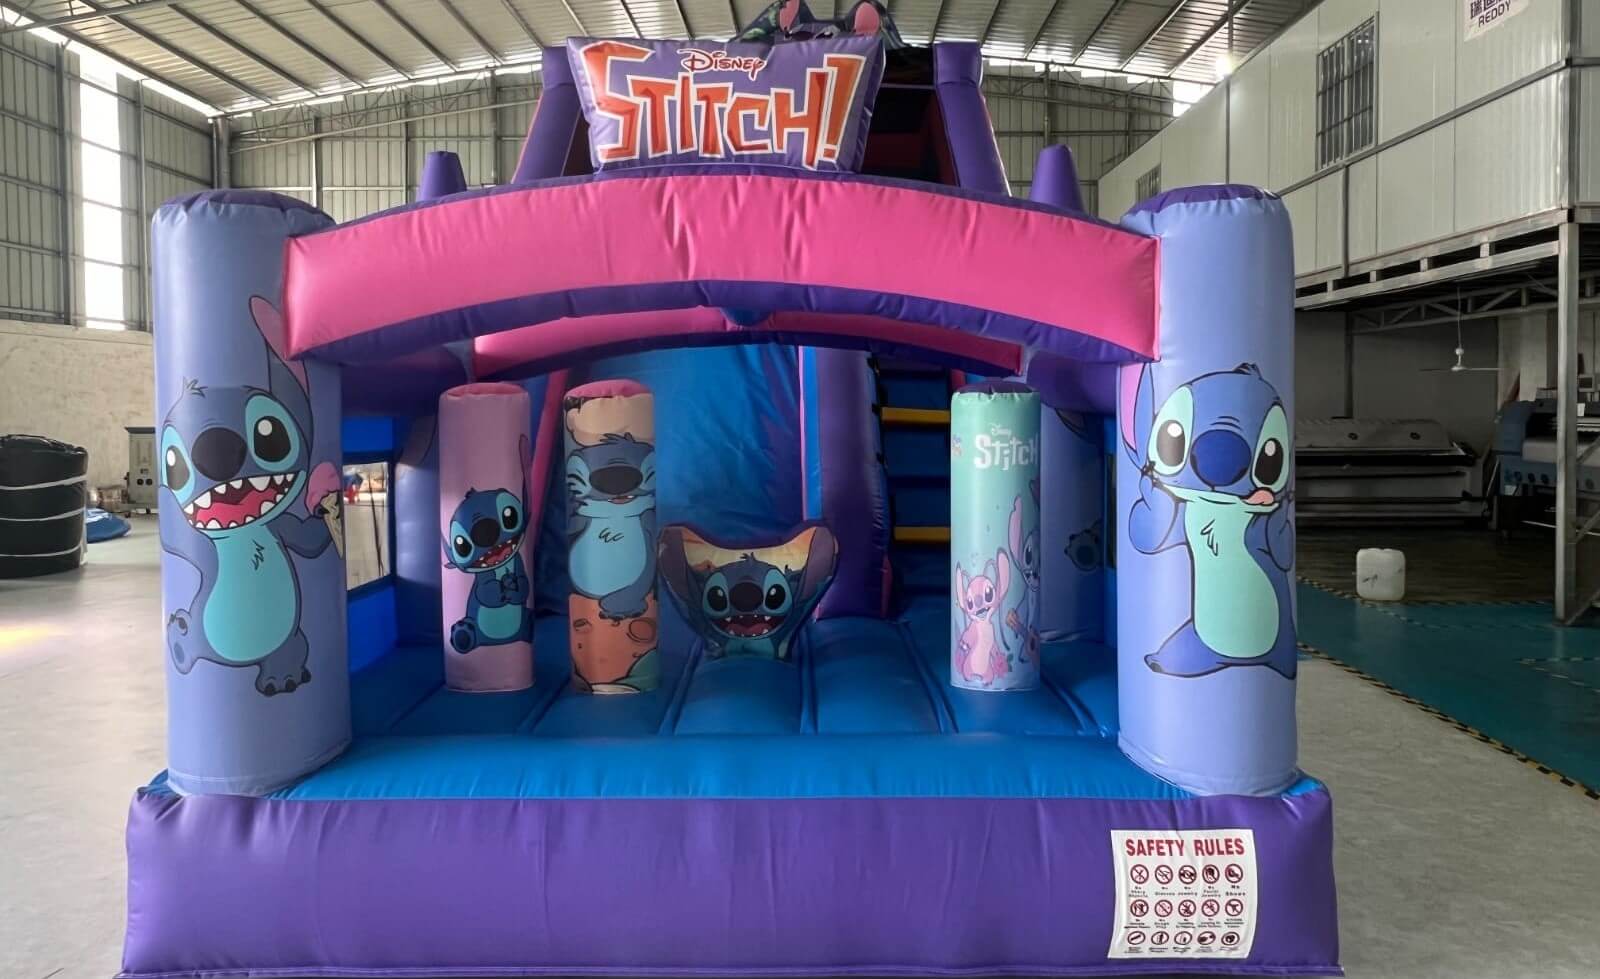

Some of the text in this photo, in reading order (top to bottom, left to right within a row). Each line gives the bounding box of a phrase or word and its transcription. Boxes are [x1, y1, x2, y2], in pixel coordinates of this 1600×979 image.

[1478, 0, 1511, 28] REDDY
[579, 40, 867, 171] STITCH!
[1125, 837, 1245, 857] SAFETY RULES
